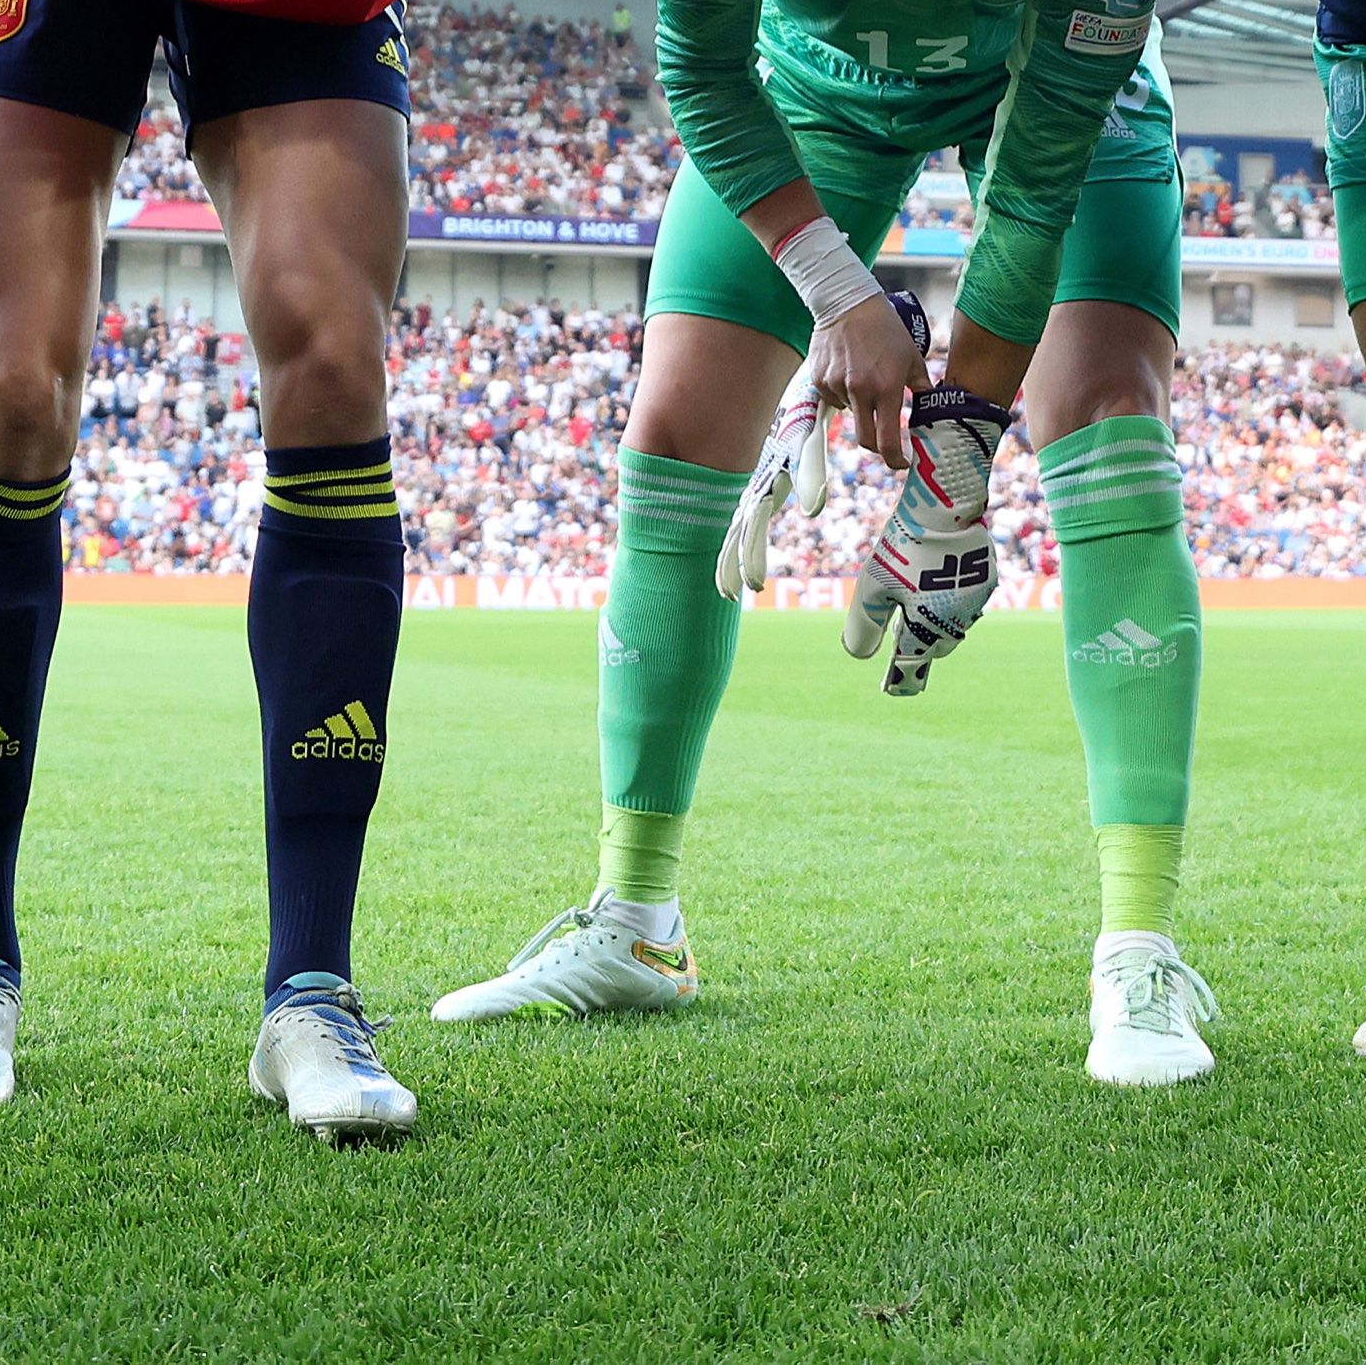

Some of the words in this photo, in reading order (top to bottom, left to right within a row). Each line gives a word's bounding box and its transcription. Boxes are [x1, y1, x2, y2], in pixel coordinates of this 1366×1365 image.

[1075, 12, 1102, 26] UEFA
[856, 30, 969, 74] 13
[442, 216, 555, 240] BRIGHTON
[557, 220, 576, 242] &
[579, 221, 639, 244] HOVE
[477, 575, 610, 609] MATC
[1071, 640, 1178, 668] adidas
[291, 735, 385, 764] adidas
